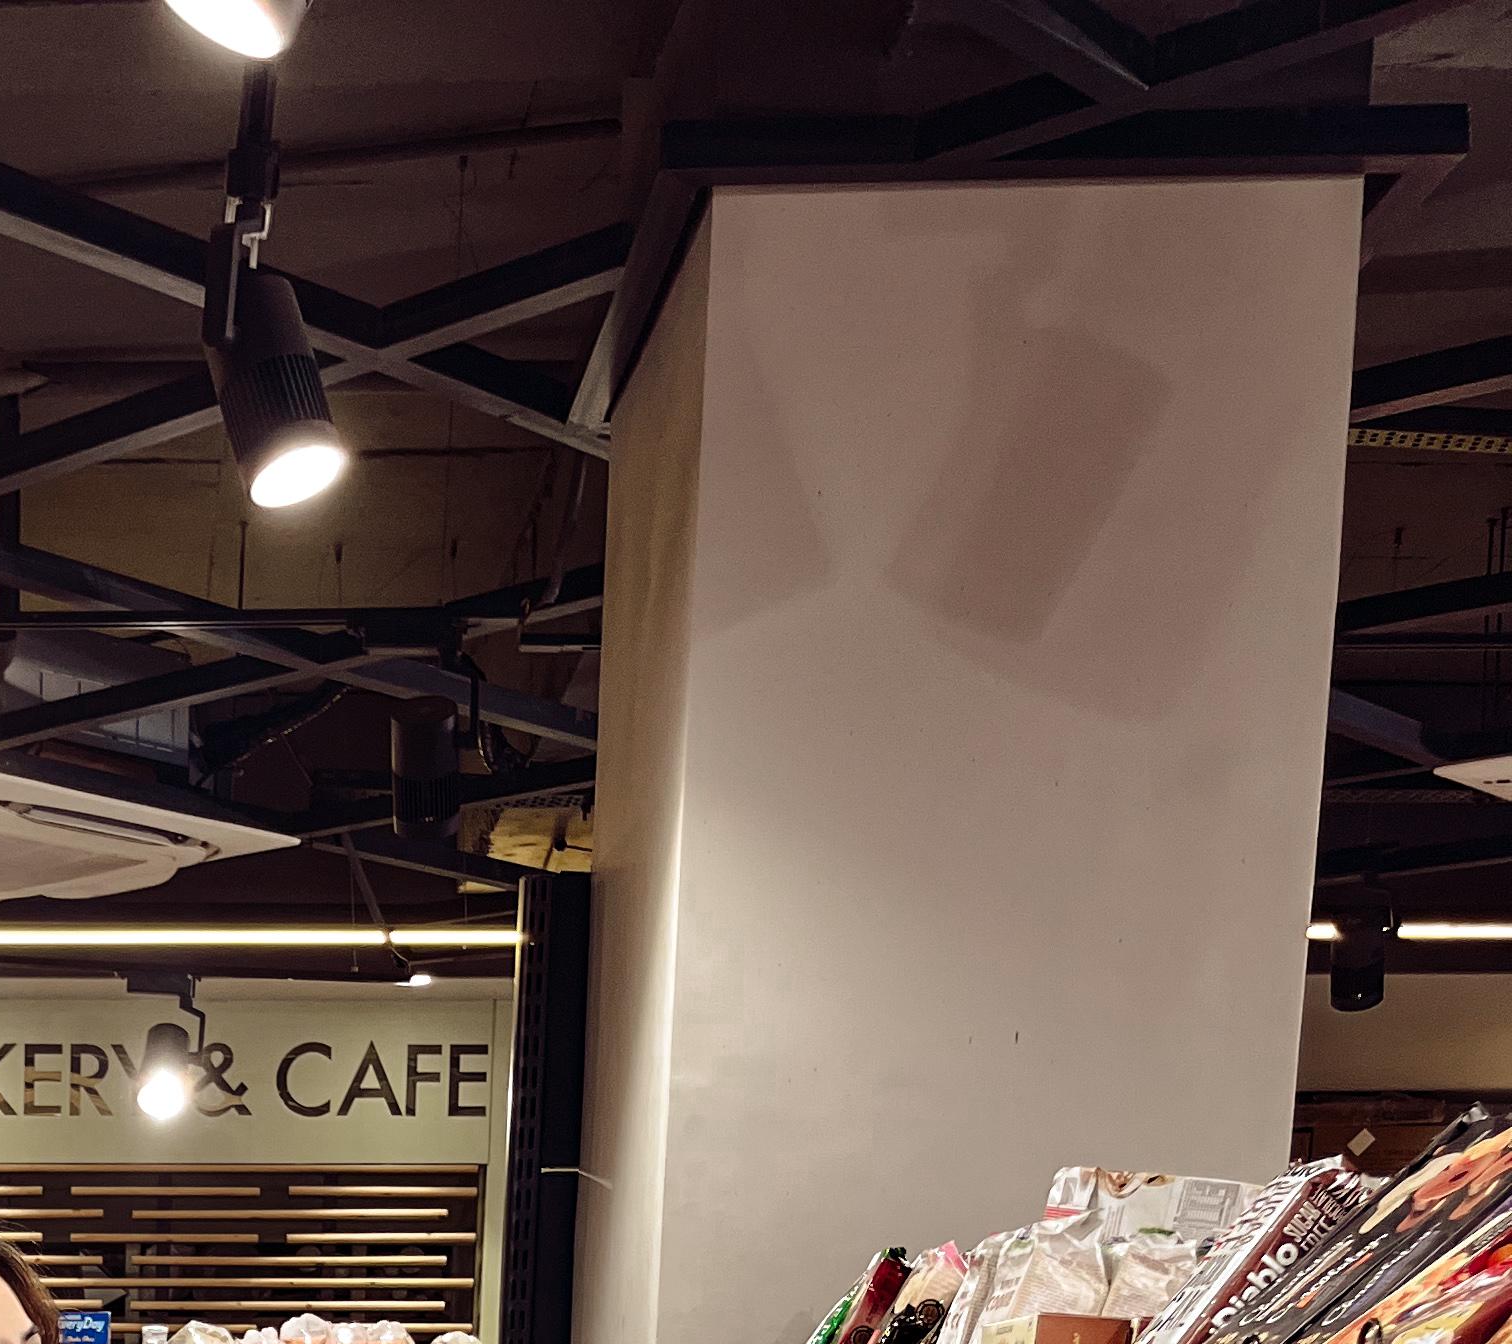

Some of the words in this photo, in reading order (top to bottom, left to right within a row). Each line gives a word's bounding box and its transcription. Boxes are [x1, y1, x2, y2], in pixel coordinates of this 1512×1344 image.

[192, 1042, 252, 1117] &
[275, 1042, 488, 1117] CAFE
[1283, 1200, 1323, 1242] SUGAR
